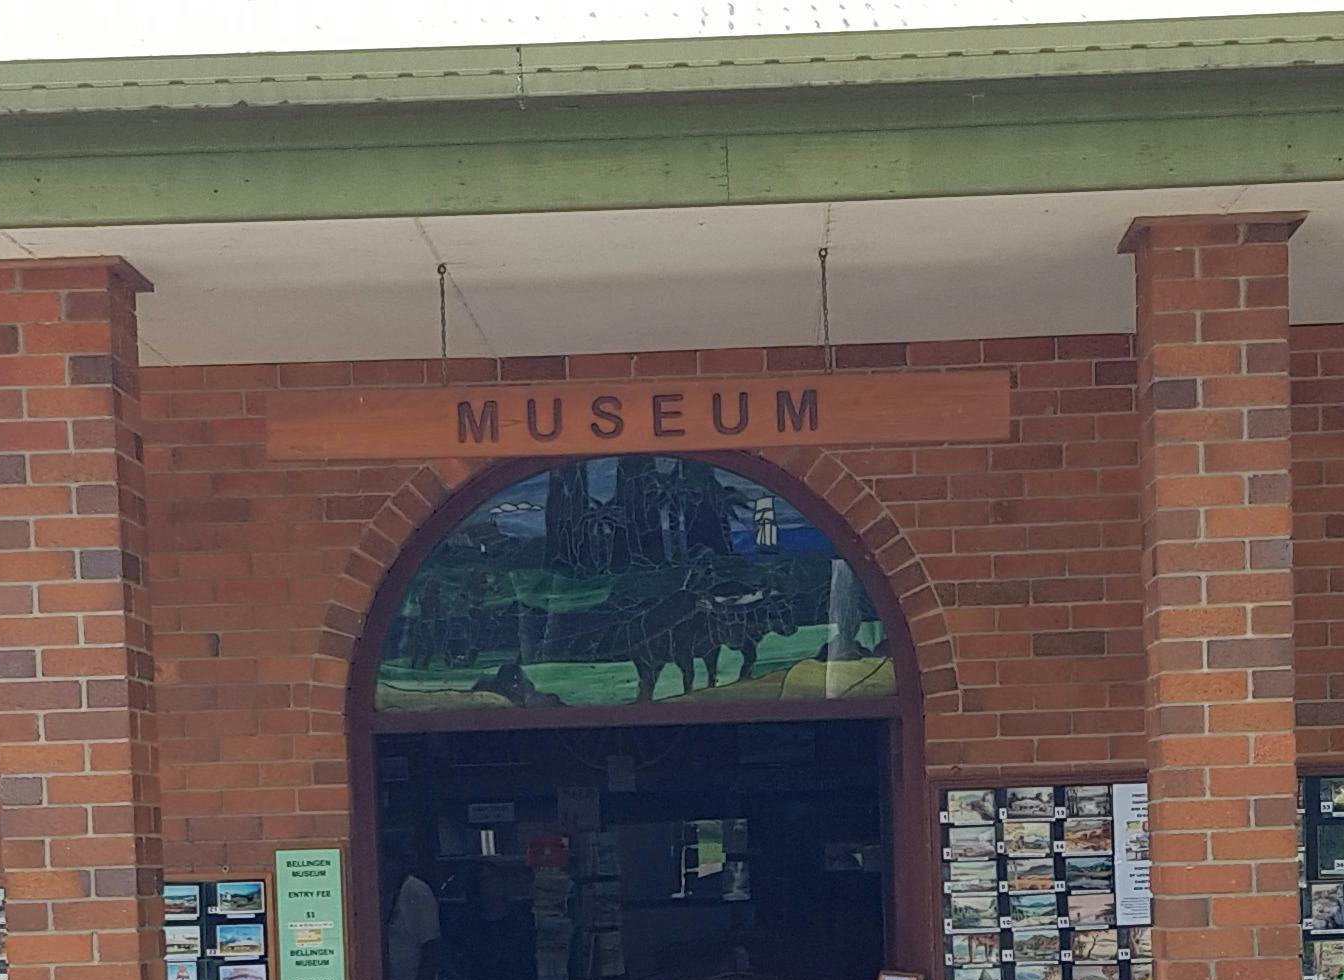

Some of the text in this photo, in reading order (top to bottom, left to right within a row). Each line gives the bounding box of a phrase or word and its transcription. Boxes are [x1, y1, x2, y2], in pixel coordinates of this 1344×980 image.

[456, 388, 821, 444] MUSEUM
[286, 860, 331, 868] BELLINGEN
[288, 890, 332, 899] ENTRY FEE
[289, 949, 335, 957] BELLINGEN
[295, 959, 330, 967] MUSEUM
